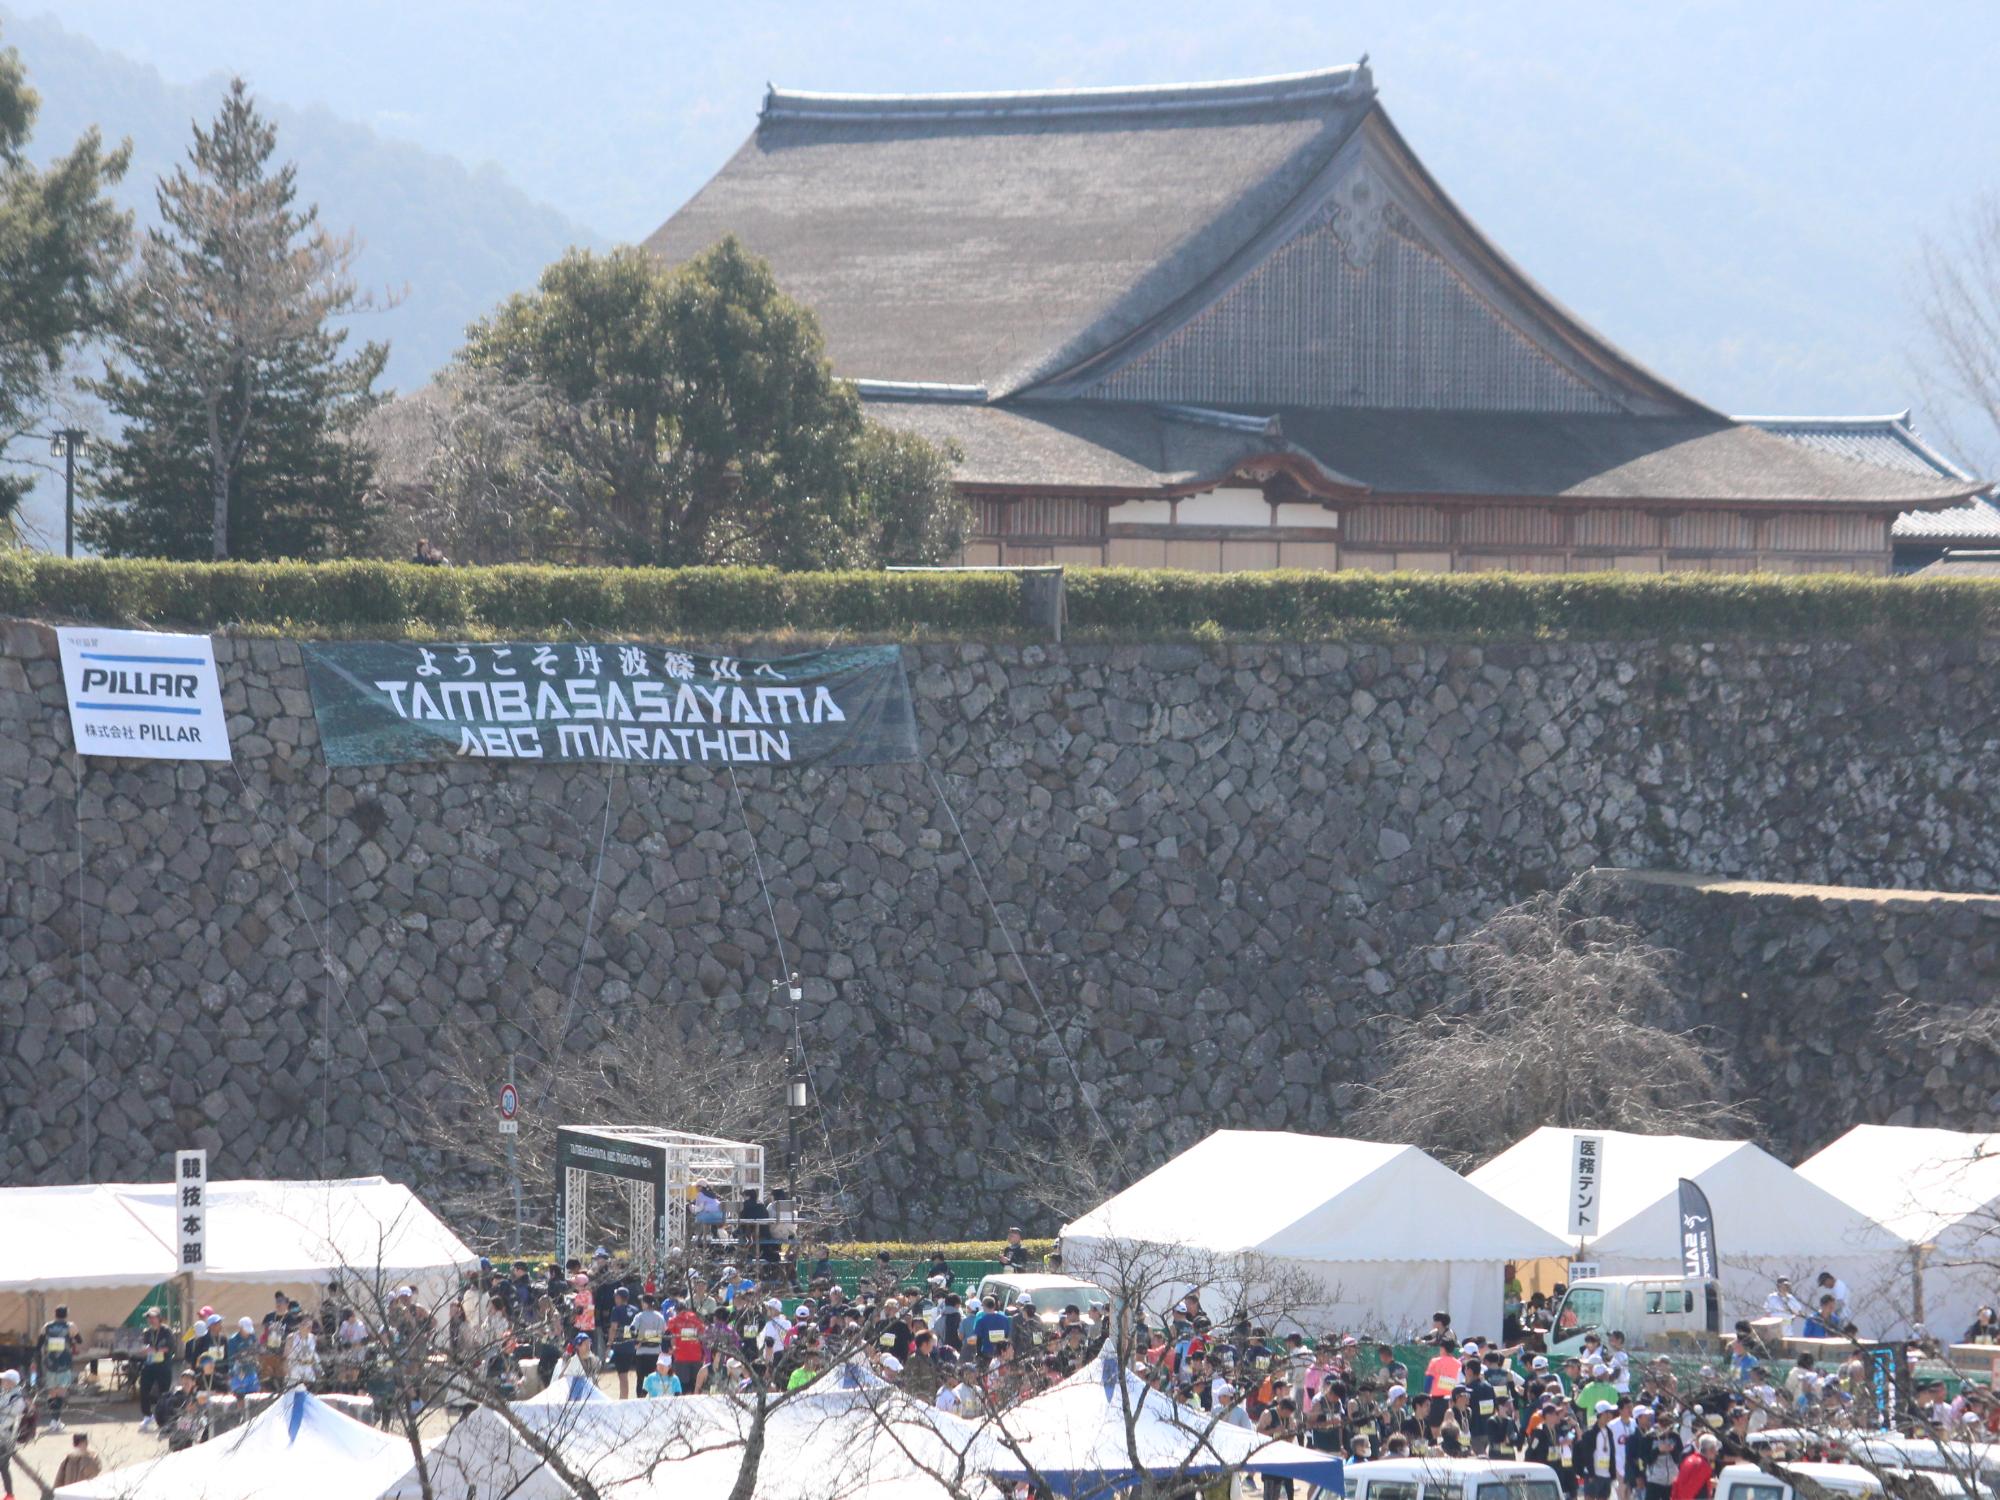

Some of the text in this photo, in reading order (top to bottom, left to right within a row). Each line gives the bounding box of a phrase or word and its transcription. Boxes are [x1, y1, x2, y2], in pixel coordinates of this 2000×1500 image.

[416, 646, 787, 681] ようこそ丹波篠山へ
[82, 668, 198, 699] PILLAR
[375, 679, 846, 723] TAMBASASAYAMA
[85, 723, 202, 743] 株式会社 PILLAR
[456, 725, 791, 761] ABC MARATHON
[1578, 1141, 1596, 1226] 医務テント
[182, 1158, 202, 1264] 競技本部
